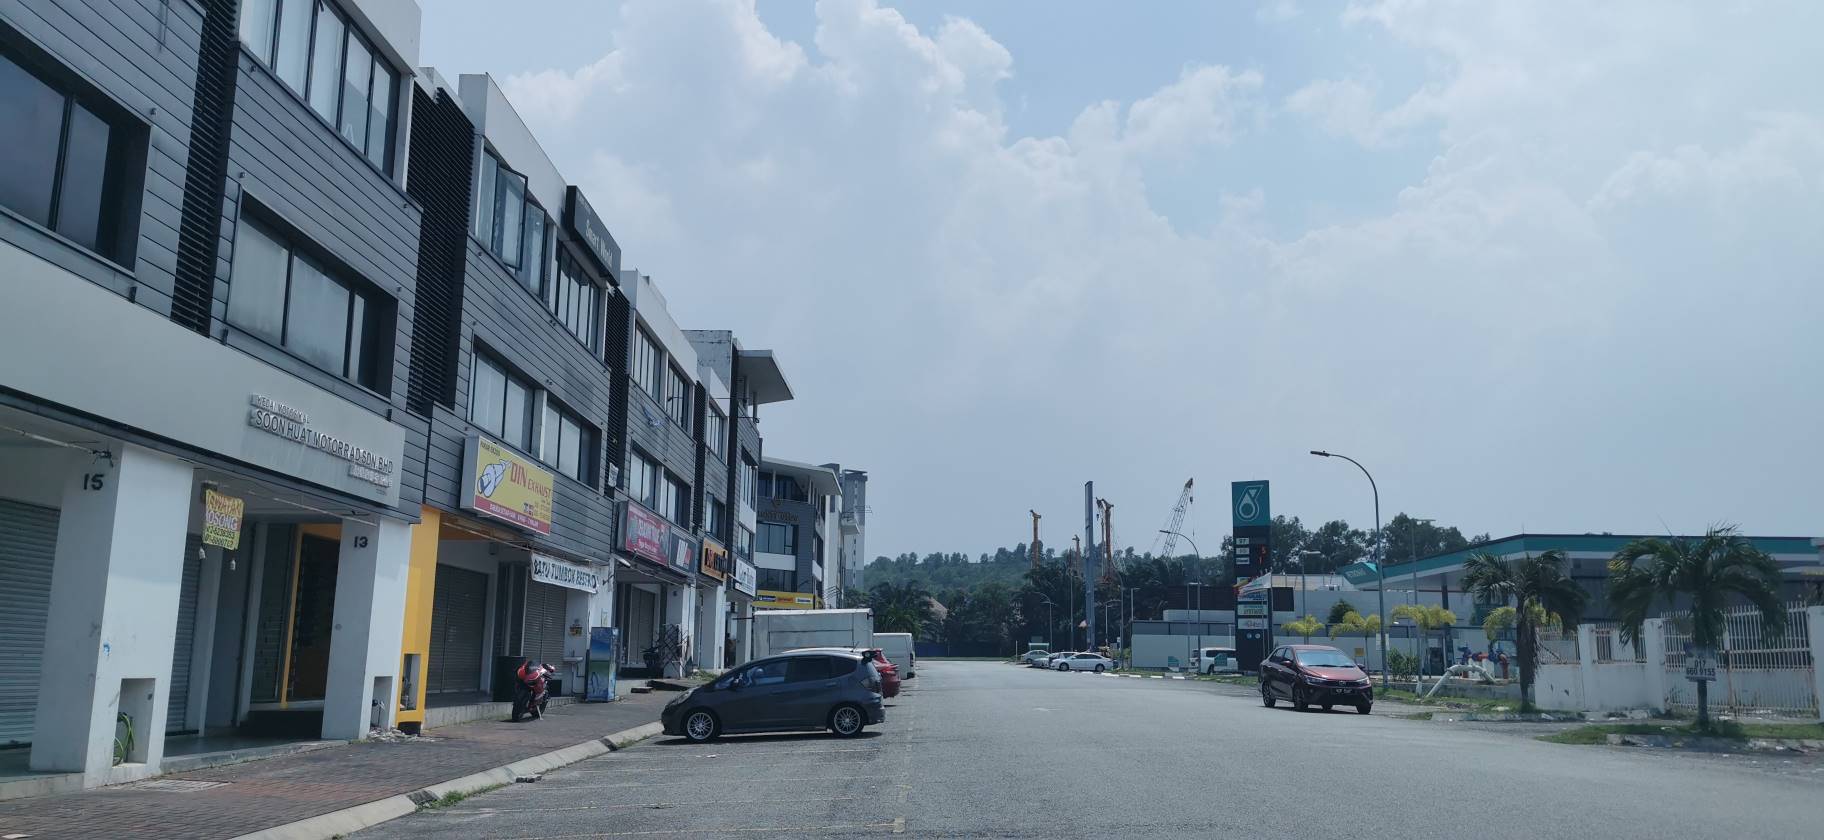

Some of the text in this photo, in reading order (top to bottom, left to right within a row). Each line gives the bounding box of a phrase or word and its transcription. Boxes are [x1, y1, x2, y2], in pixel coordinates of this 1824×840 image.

[255, 410, 285, 434] SOON
[287, 421, 313, 442] HUAT
[313, 432, 361, 462] MOTORRAD
[378, 456, 393, 474] BHD
[83, 473, 104, 490] 15
[510, 461, 551, 498] DIN EXHAUST
[354, 536, 368, 548] 13
